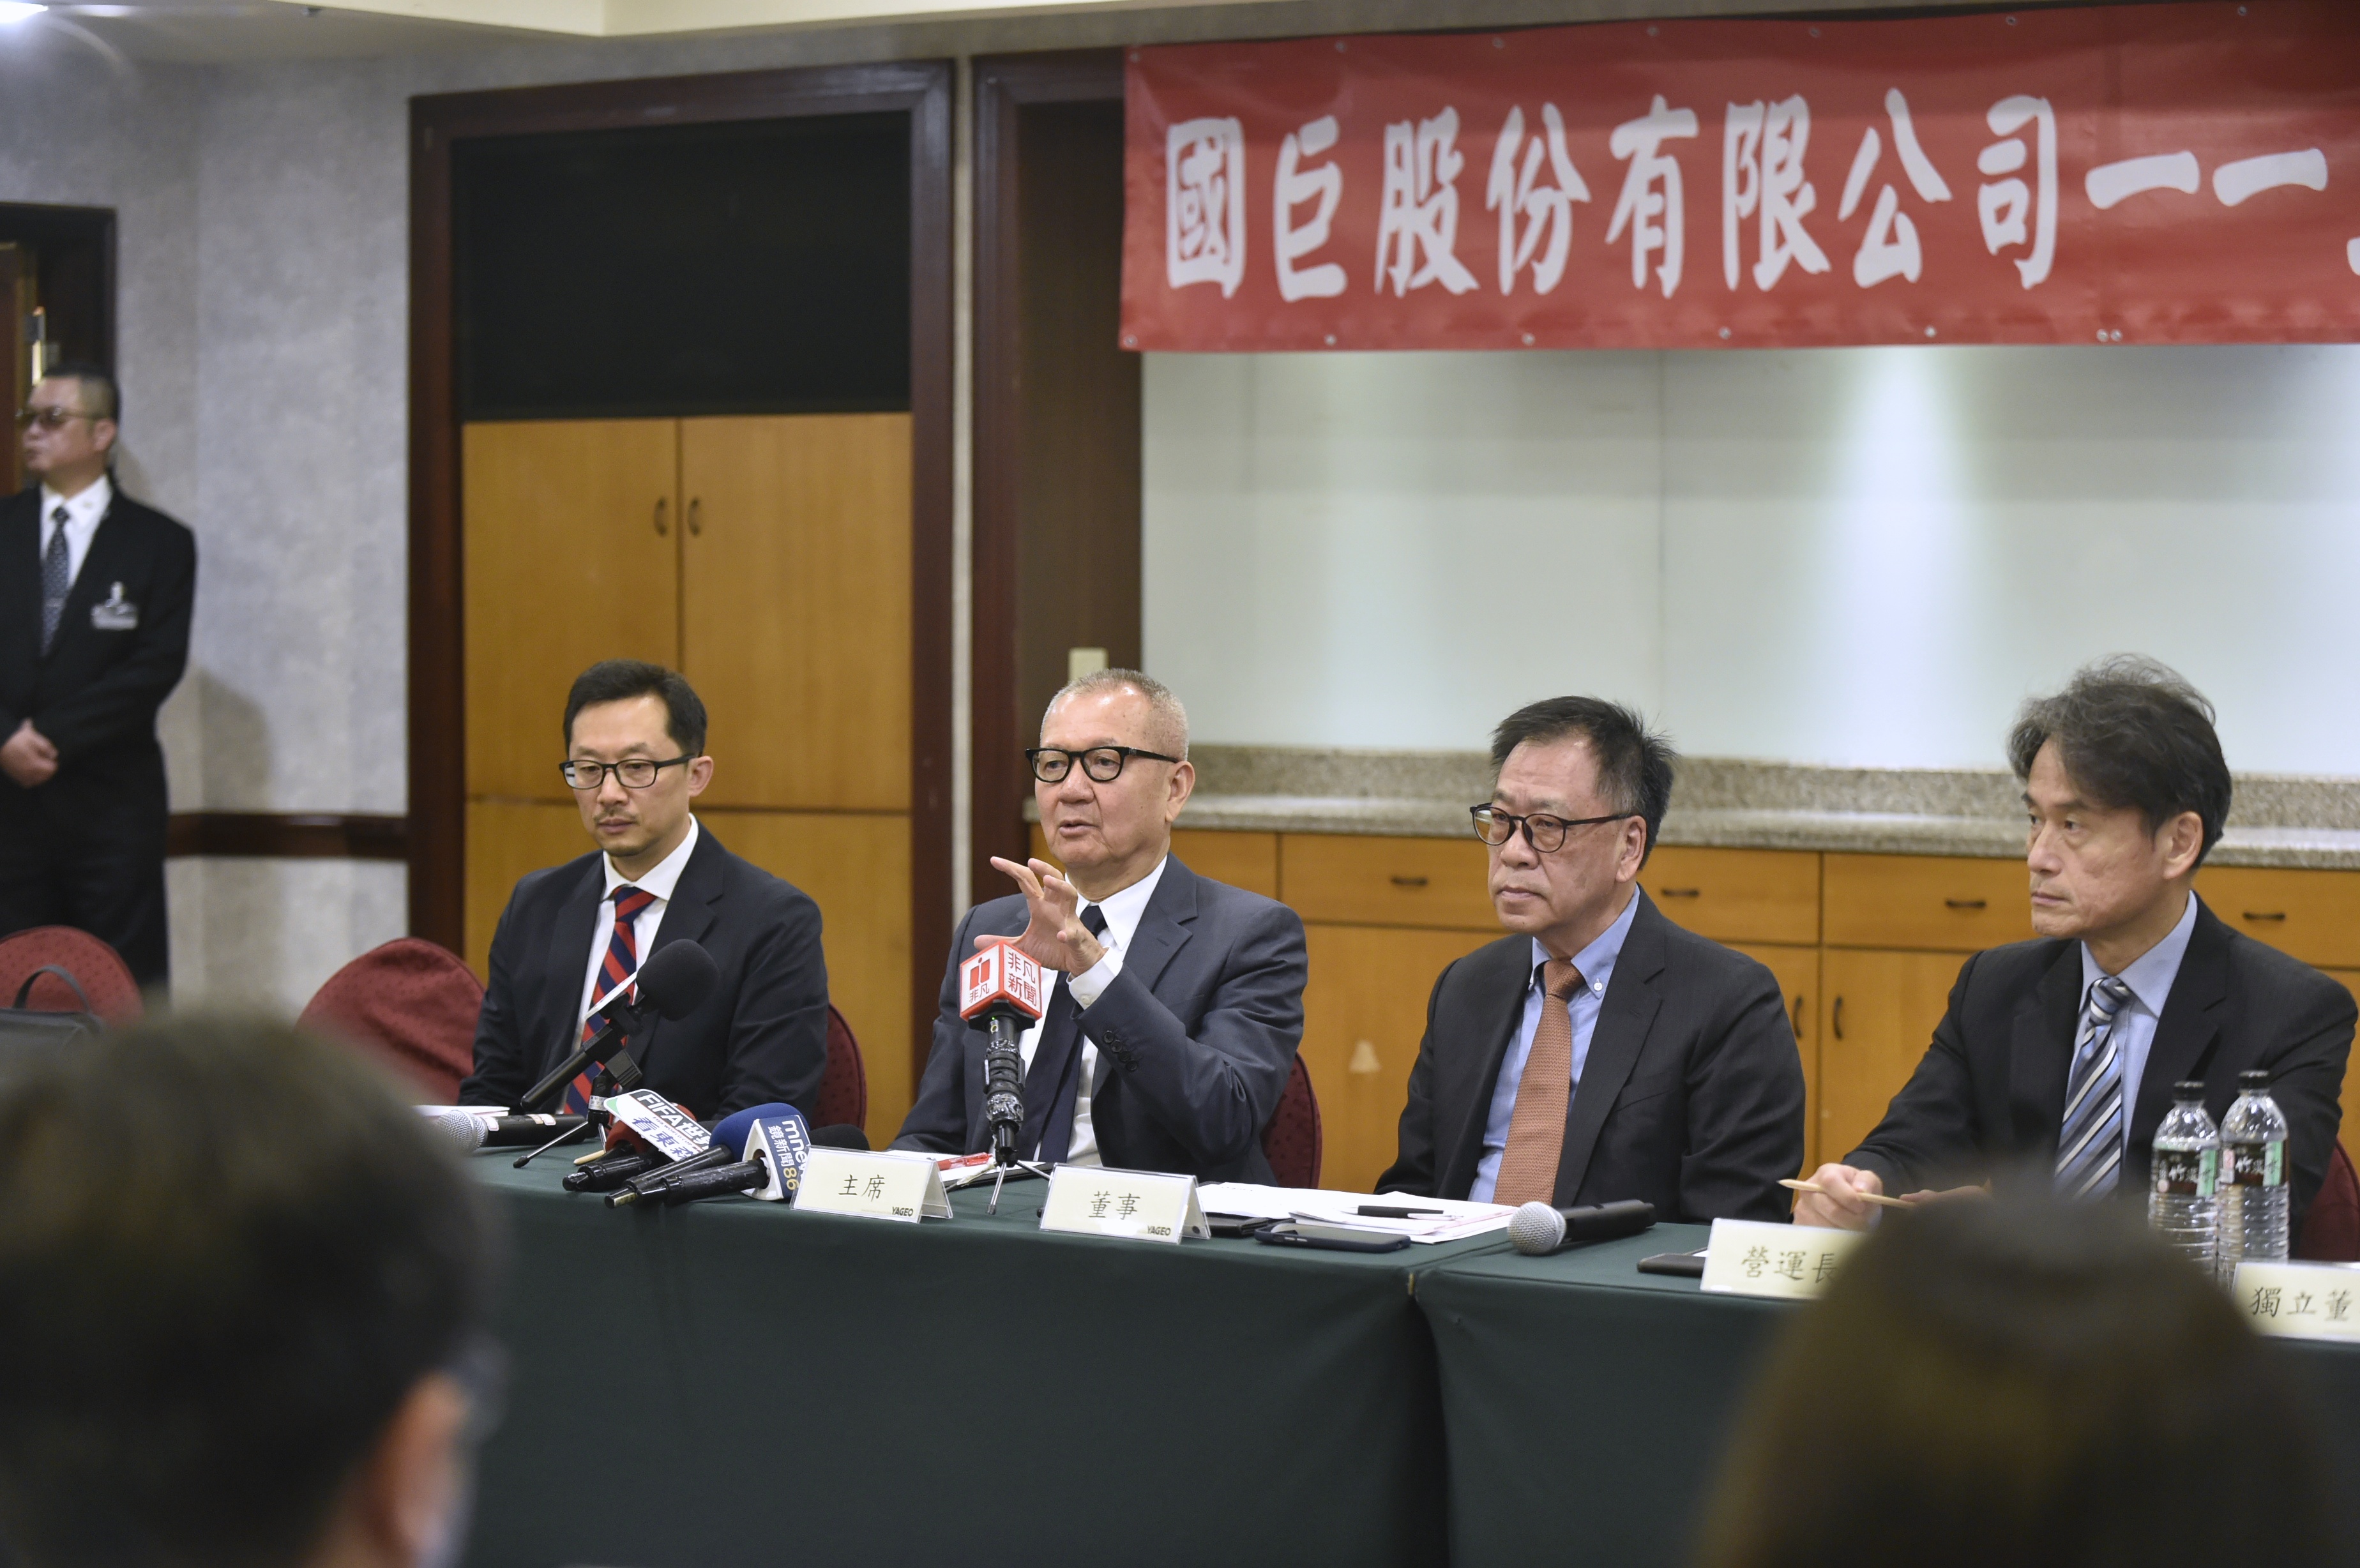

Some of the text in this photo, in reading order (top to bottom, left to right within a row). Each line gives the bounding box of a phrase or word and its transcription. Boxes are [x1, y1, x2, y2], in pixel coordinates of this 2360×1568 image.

[1166, 88, 2360, 302] 國巨股份有限公司一一
[1008, 952, 1036, 984] 非凡
[969, 983, 989, 1003] 非凡
[1008, 972, 1037, 1006] 新聞
[838, 1174, 885, 1202] 主席
[892, 1206, 914, 1217] YAGEO
[1088, 1191, 1141, 1220] 董事
[1147, 1225, 1171, 1236] YAGEO
[1741, 1246, 1837, 1283] 營運長
